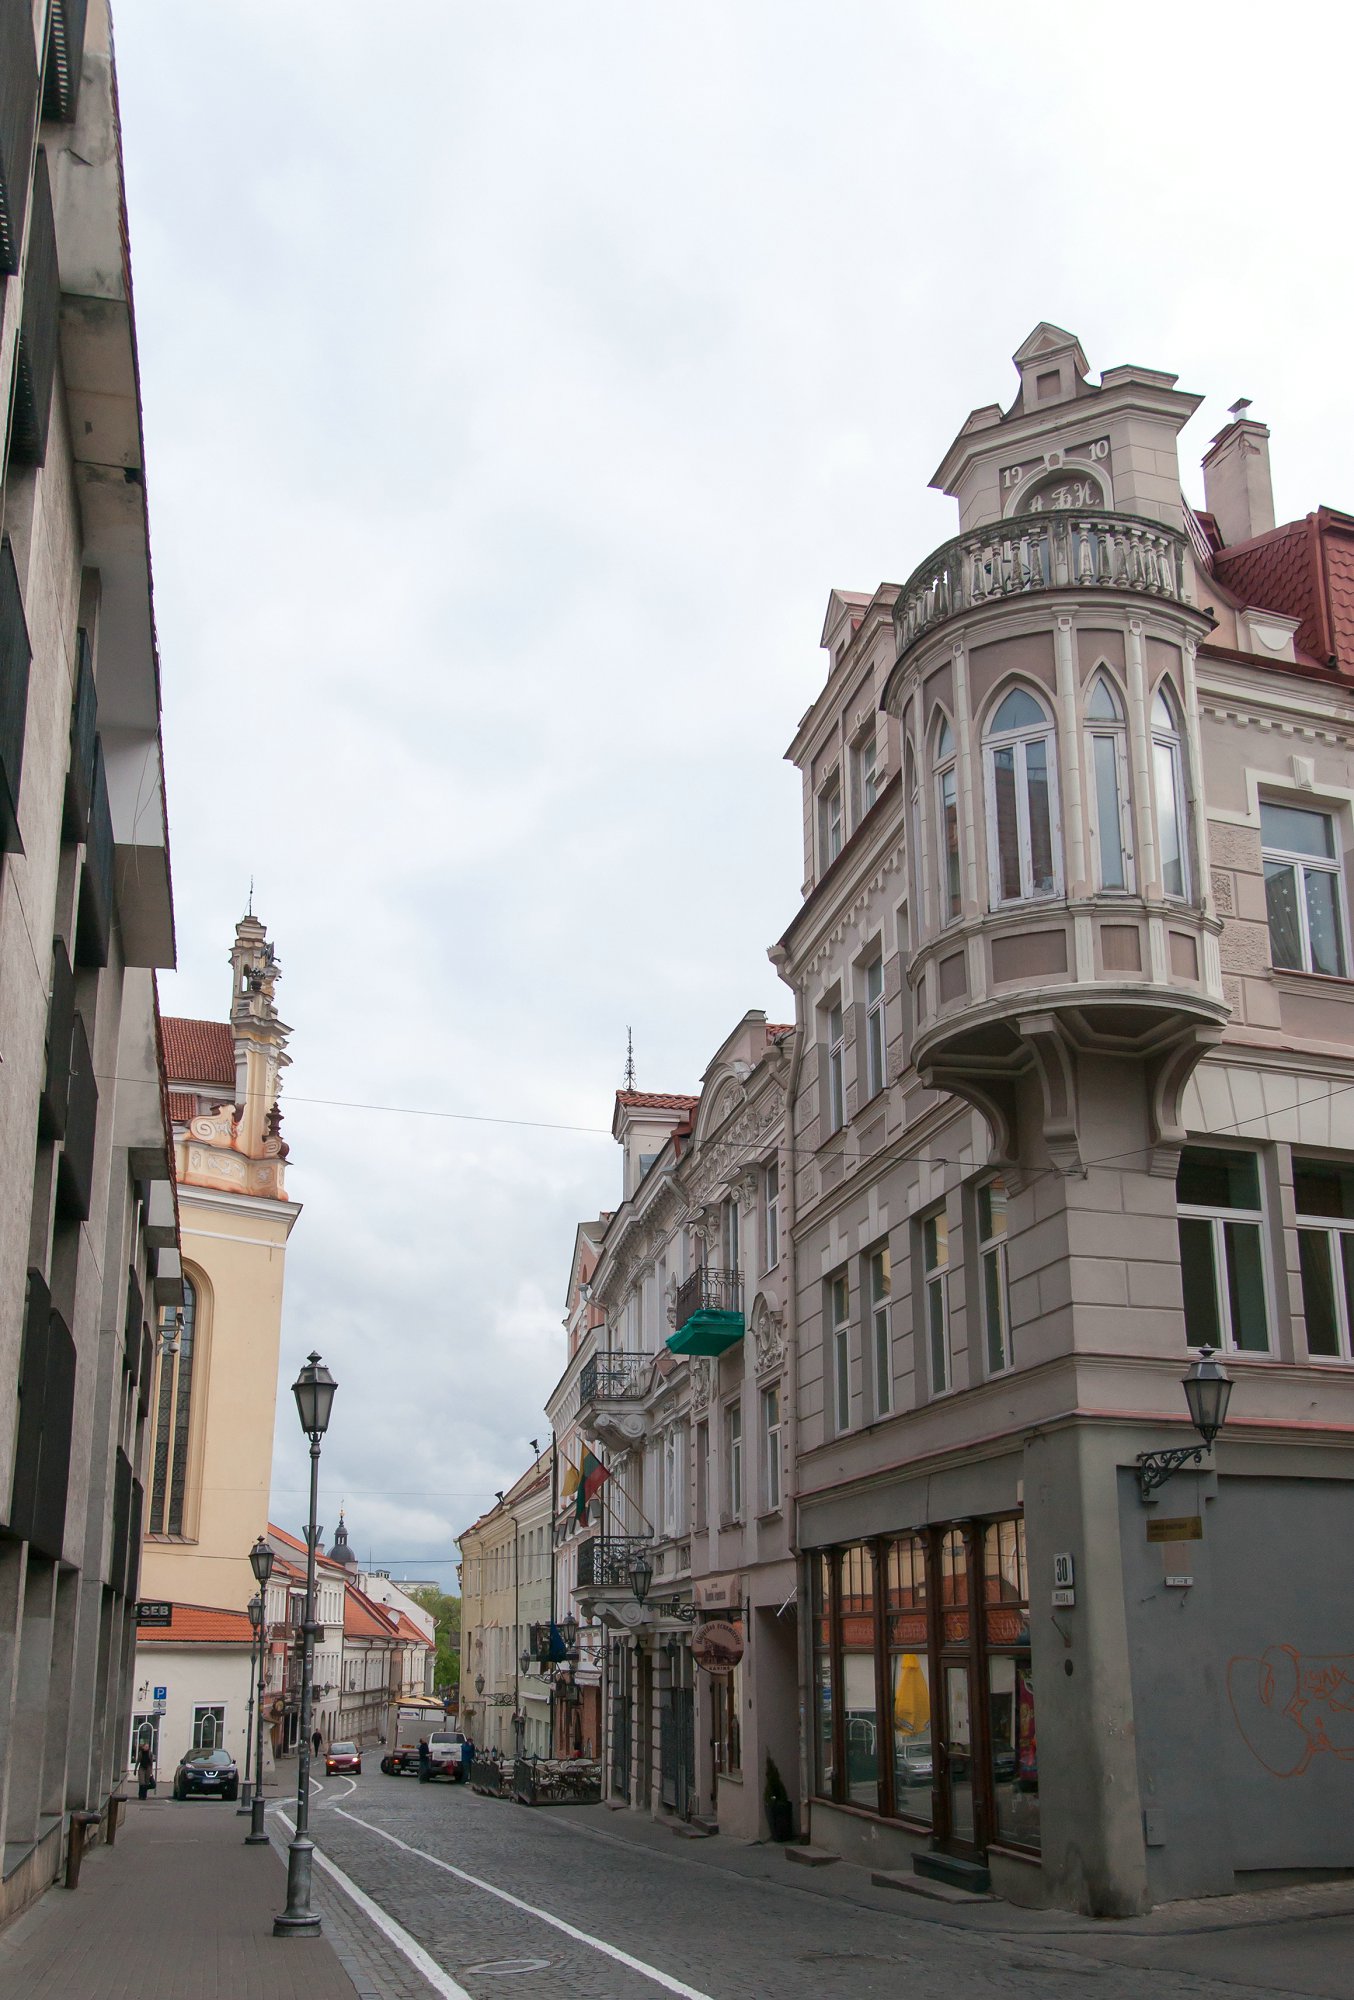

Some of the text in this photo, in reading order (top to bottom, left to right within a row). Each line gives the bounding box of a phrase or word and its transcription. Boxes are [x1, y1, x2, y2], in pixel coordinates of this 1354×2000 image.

[1088, 439, 1109, 461] 10
[1003, 466, 1023, 489] 19
[1056, 1557, 1068, 1582] 30
[141, 1605, 169, 1616] SEB
[157, 1688, 165, 1698] P
